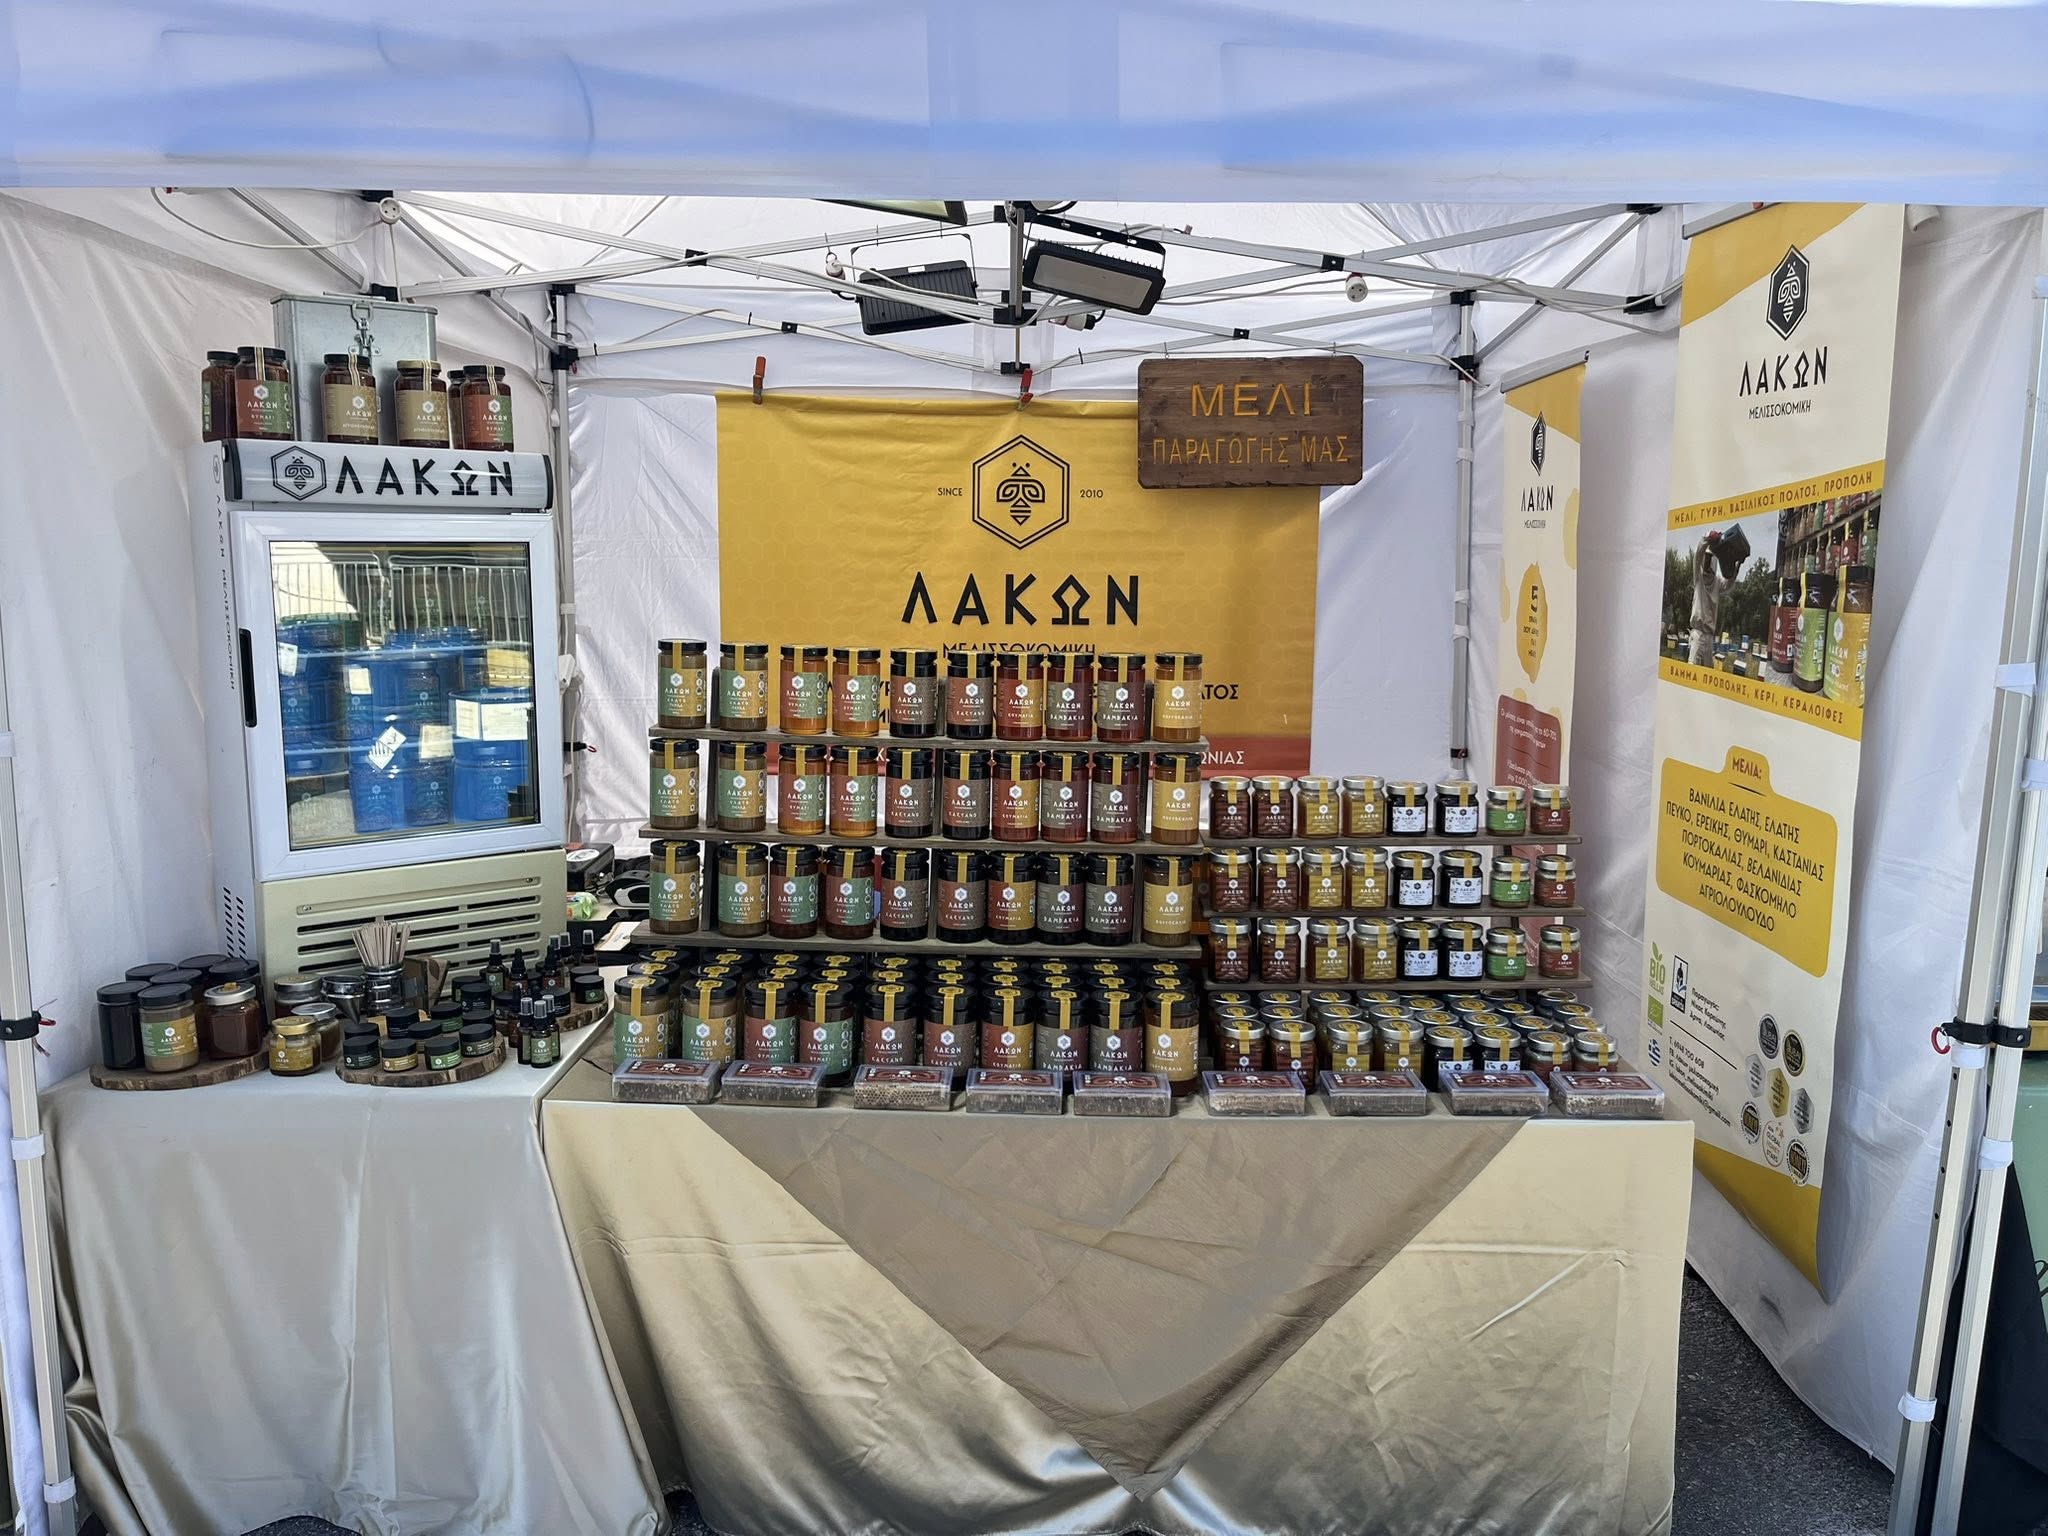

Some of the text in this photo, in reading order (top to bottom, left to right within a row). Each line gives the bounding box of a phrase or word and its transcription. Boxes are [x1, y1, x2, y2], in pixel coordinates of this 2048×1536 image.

[1739, 346, 1828, 397] ΛΑΚΩΝ
[1191, 382, 1312, 417] ΜΕΛΙ
[247, 401, 278, 409] ΛΑΚΩΝ
[1749, 399, 1812, 420] ΜΕΛΙΣΣΟΚΟΜΙΚΗ
[1153, 435, 1348, 465] ΠΑΡΑΓΩΓΗΣ ΜΑΣ
[335, 455, 513, 496] ΛΑΚΩΝ
[937, 487, 963, 497] SINCE
[1080, 489, 1104, 498] 2010
[1729, 493, 1775, 514] ΒΑΣΙΛΙΚΟΣ
[1824, 471, 1873, 493] ΠΡΟΠΟΛΗ
[1521, 485, 1553, 512] ΛΑΚΩΝ
[901, 571, 1139, 626] ΛΑΚΩΝ
[1670, 666, 1844, 724] ΒΑΜΜΑ ΠΡΟΠΟΛΗΣ, ΚΕΡΙ, ΚΕΡΑΛΟΙΦΕΣ
[1732, 757, 1762, 780] ΜΕΛΙΑ:
[1102, 804, 1129, 812] ΛΑΚΩΝ
[1689, 788, 1800, 844] ΒΑΝΙΛΙΑ ΕΛΑΤΗΣ, ΕΛΑΤΗΣ
[1666, 801, 1825, 882] ΠΕΥΚΟ, ΕΡΕΙΚΗΣ, ΘΥΜΑΡΙ, ΚΑΣΤΑΝΙΑΣ
[1682, 828, 1802, 898] ΠΟΡΤΟΚΑΛΙΑΣ, ΒΕΛΑΝΙΔΙΑΣ
[1682, 852, 1797, 919] ΚΟΥΜΑΡΙΑΣ, ΦΑΣΚΟΜΗΛΟ
[834, 896, 860, 904] ΛΑΚΩΝ
[888, 900, 913, 908] ΛΑΚΩΝ
[1051, 904, 1076, 912] ΛΑΚΩΝ
[1699, 884, 1774, 932] ΑΓΡΙΟΛΟΥΛΟΥΔΟ
[1650, 958, 1666, 984] BIO
[622, 1036, 650, 1044] ΛΑΚΩΝ
[690, 1039, 718, 1048] ΛΑΚΩΝ
[755, 1040, 784, 1048] ΛΑΚΩΝ
[807, 1042, 835, 1050] ΛΑΚΩΝ
[874, 1042, 902, 1050] ΛΑΚΩΝ
[934, 1046, 962, 1054] ΛΑΚΩΝ
[994, 1047, 1022, 1055] ΛΑΚΩΝ
[1050, 1050, 1079, 1058] ΛΑΚΩΝ
[1100, 1050, 1128, 1058] ΛΑΚΩΝ
[1152, 1048, 1180, 1057] ΛΑΚΩΝ
